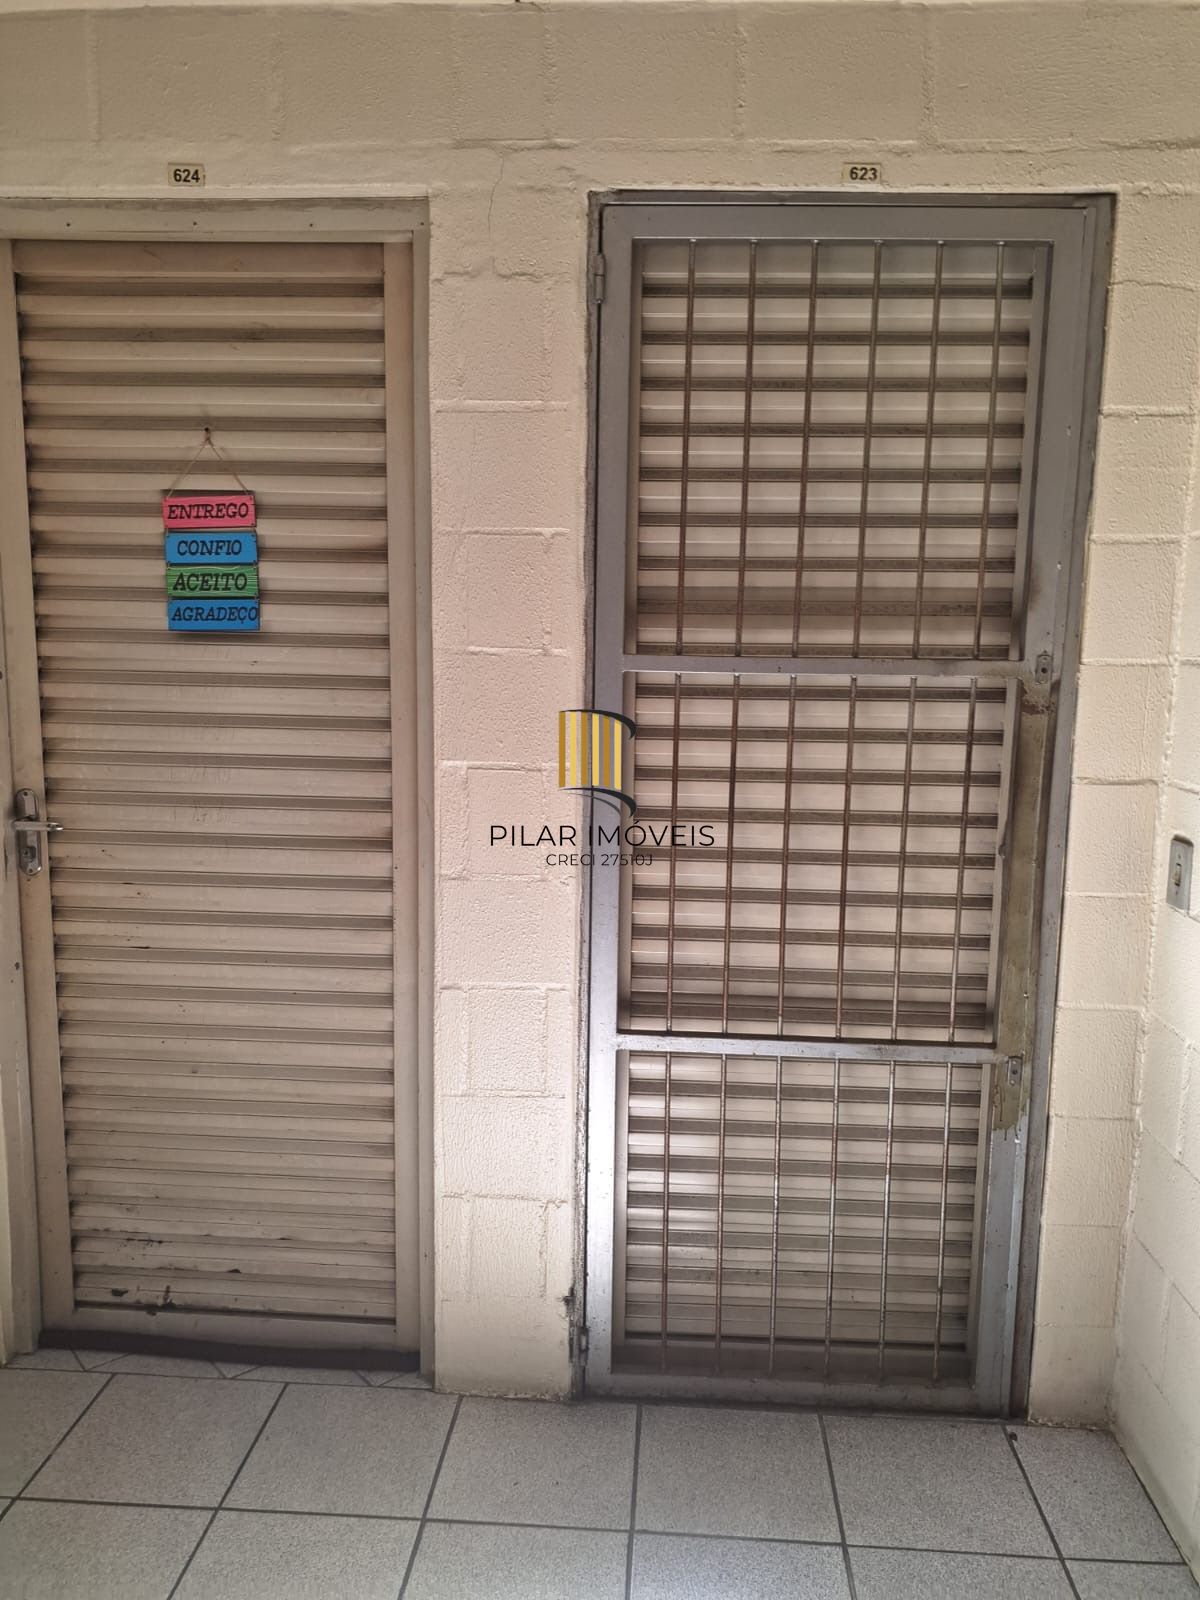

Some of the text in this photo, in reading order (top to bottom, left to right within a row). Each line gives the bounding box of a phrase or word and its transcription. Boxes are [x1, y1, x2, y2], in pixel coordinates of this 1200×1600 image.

[173, 168, 201, 183] 624
[850, 166, 878, 181] 623
[167, 502, 249, 520] ENTREGO
[177, 539, 242, 556] CONFIO
[172, 572, 247, 592] ACEITO
[171, 606, 259, 624] AGRADEÇO
